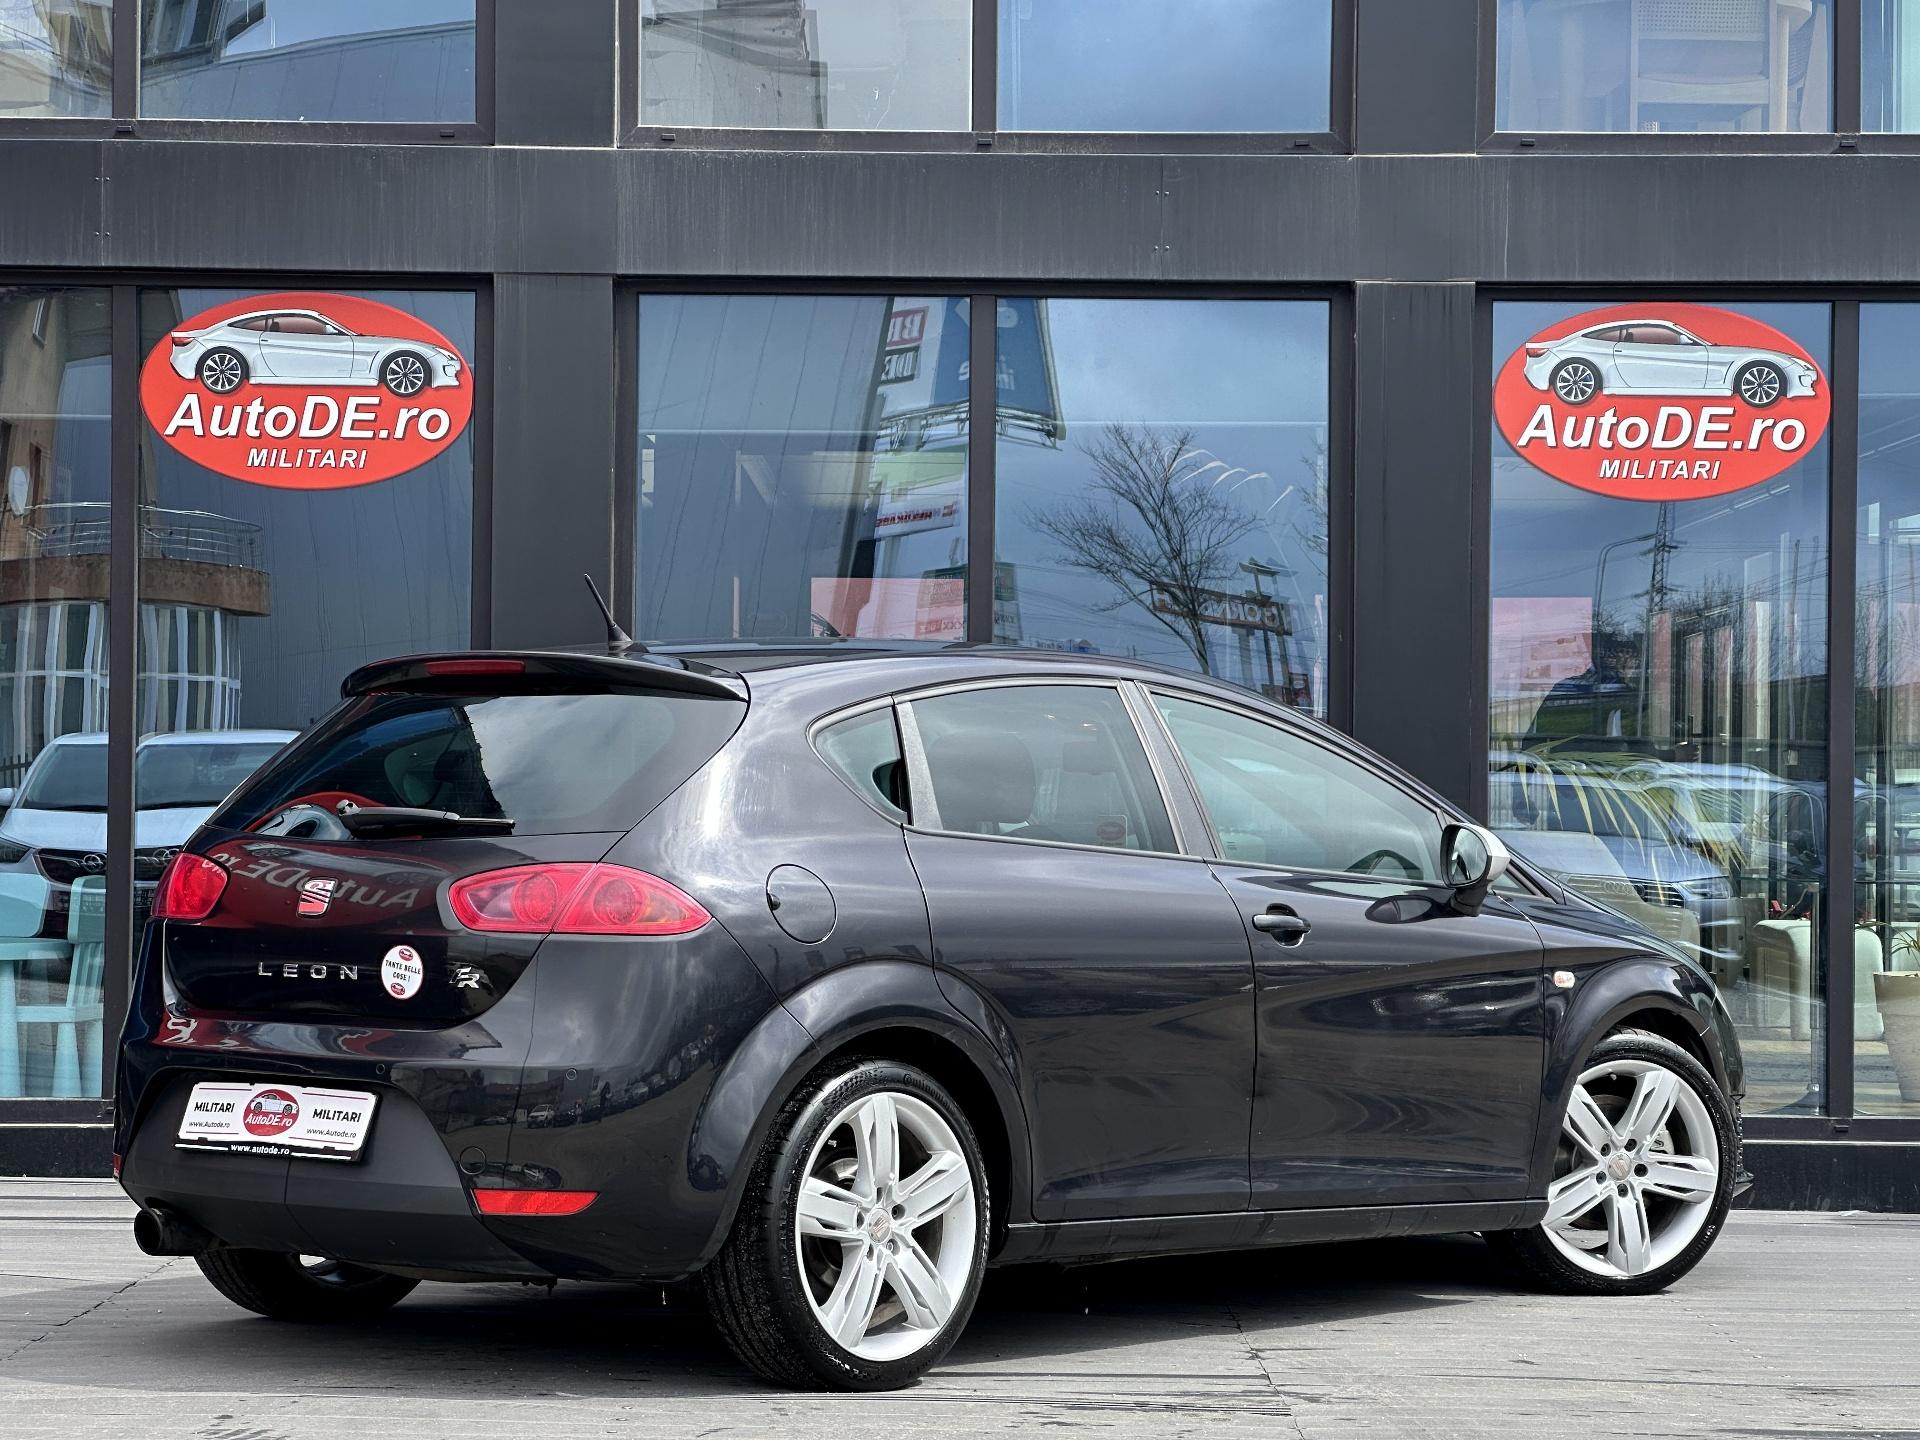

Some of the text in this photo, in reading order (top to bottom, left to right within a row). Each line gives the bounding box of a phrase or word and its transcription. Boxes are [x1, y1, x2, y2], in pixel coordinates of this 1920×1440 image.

[164, 393, 450, 440] AutoDE.ro
[1516, 404, 1806, 452] AutoDE.ro
[247, 448, 367, 469] MILITARI
[1598, 459, 1721, 480] MILITARI
[257, 961, 358, 980] LEON
[385, 959, 421, 975] TANTE BELLE
[193, 1101, 235, 1114] MILITARI
[244, 1112, 293, 1127] AutoDE.ro
[312, 1108, 361, 1123] MILITARI
[188, 1120, 231, 1129] www.Autode.ro
[306, 1127, 357, 1139] www.Autode.ro
[230, 1143, 290, 1155] www.autode.ro
